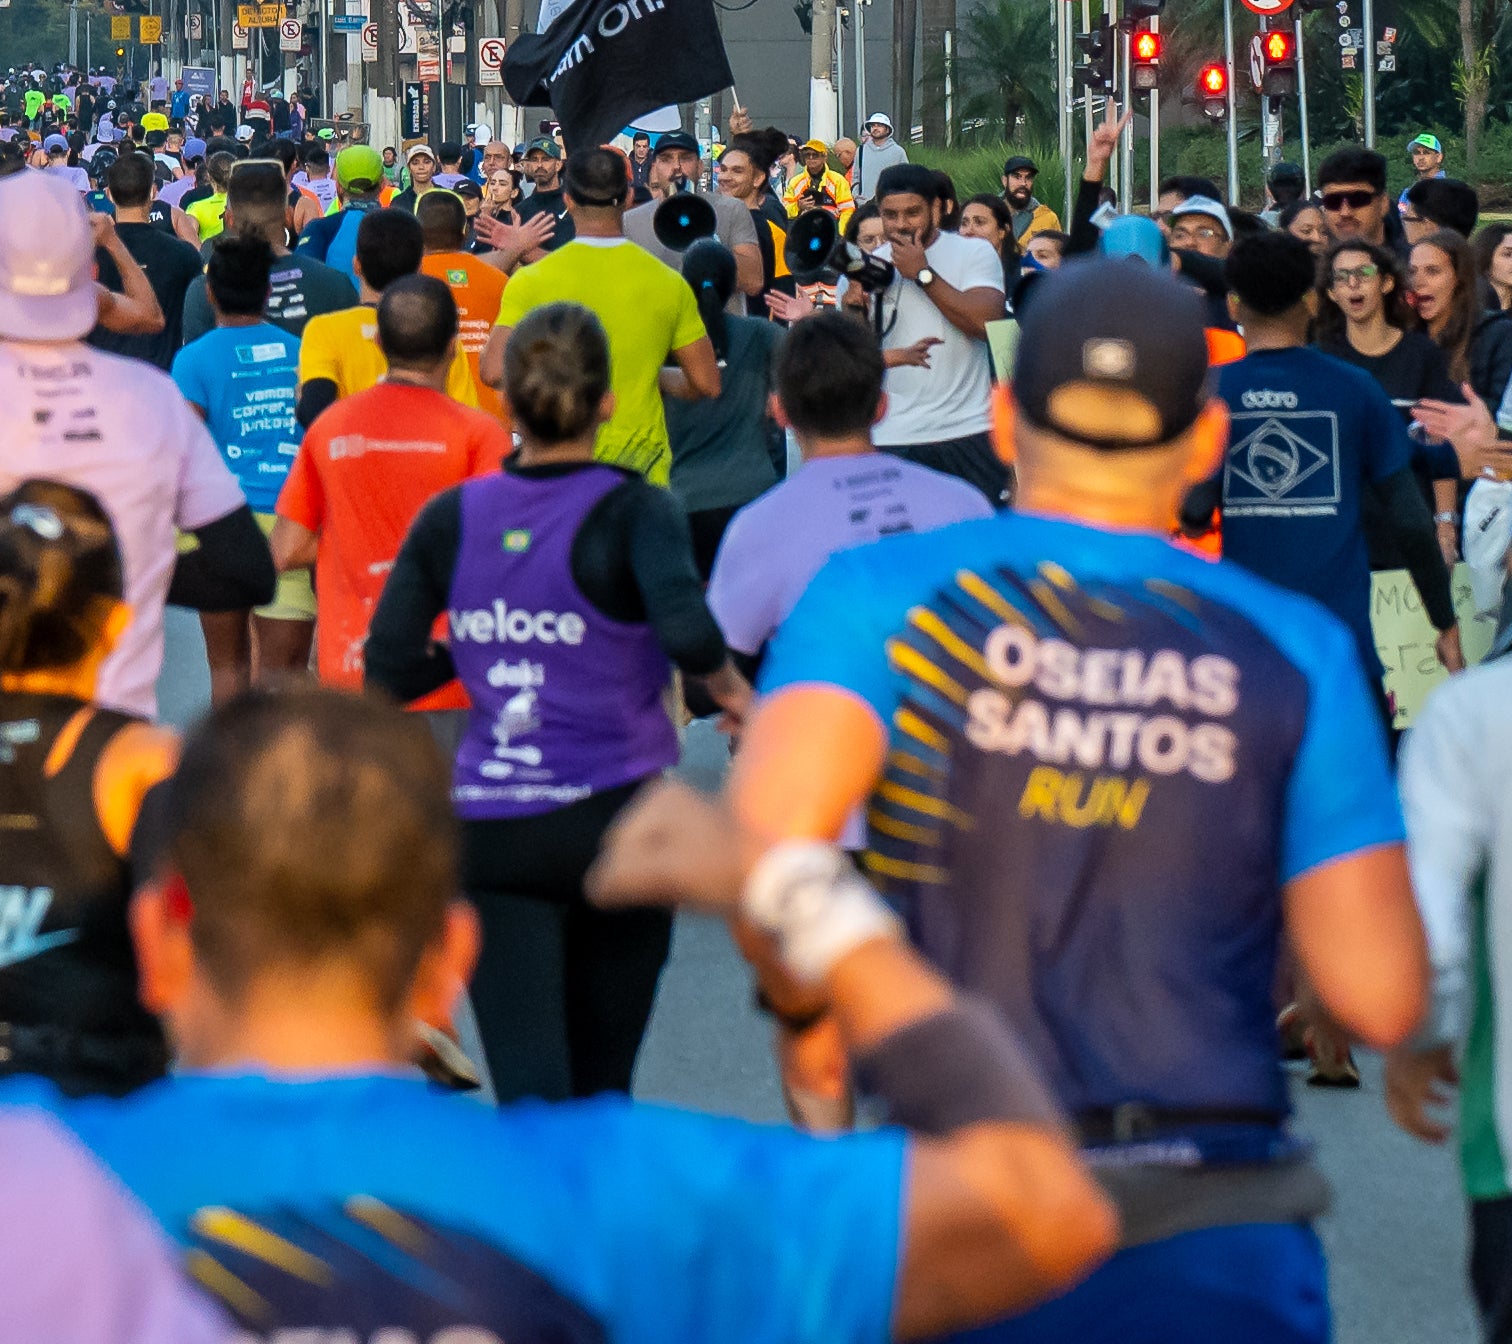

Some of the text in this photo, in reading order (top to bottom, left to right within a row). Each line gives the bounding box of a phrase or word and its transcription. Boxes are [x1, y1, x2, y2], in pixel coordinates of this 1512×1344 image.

[448, 598, 587, 645] veloce
[984, 623, 1241, 717] OSEIAS
[965, 688, 1239, 784] SANTOS
[1019, 766, 1151, 830] RUN
